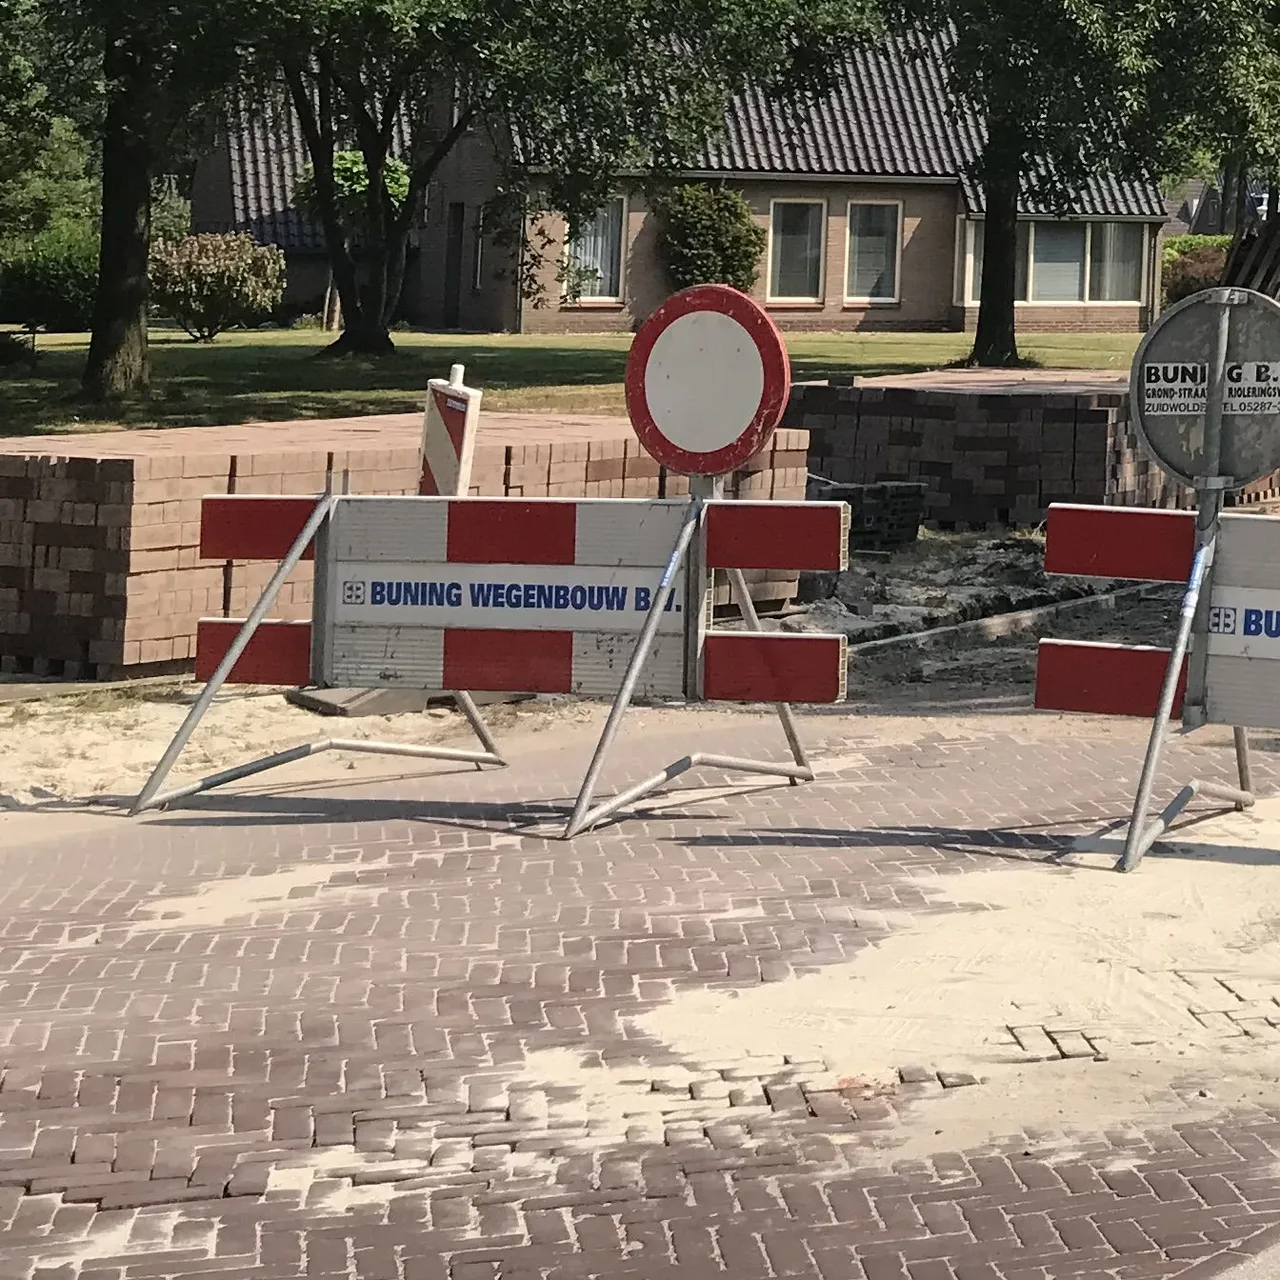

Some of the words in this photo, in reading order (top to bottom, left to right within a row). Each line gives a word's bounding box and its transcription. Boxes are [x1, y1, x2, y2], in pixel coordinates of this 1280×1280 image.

[1146, 365, 1243, 383] BUNIG
[1145, 387, 1208, 399] GROND-STRAA
[371, 581, 462, 606] BUNING
[469, 583, 628, 611] WEGENBOUW
